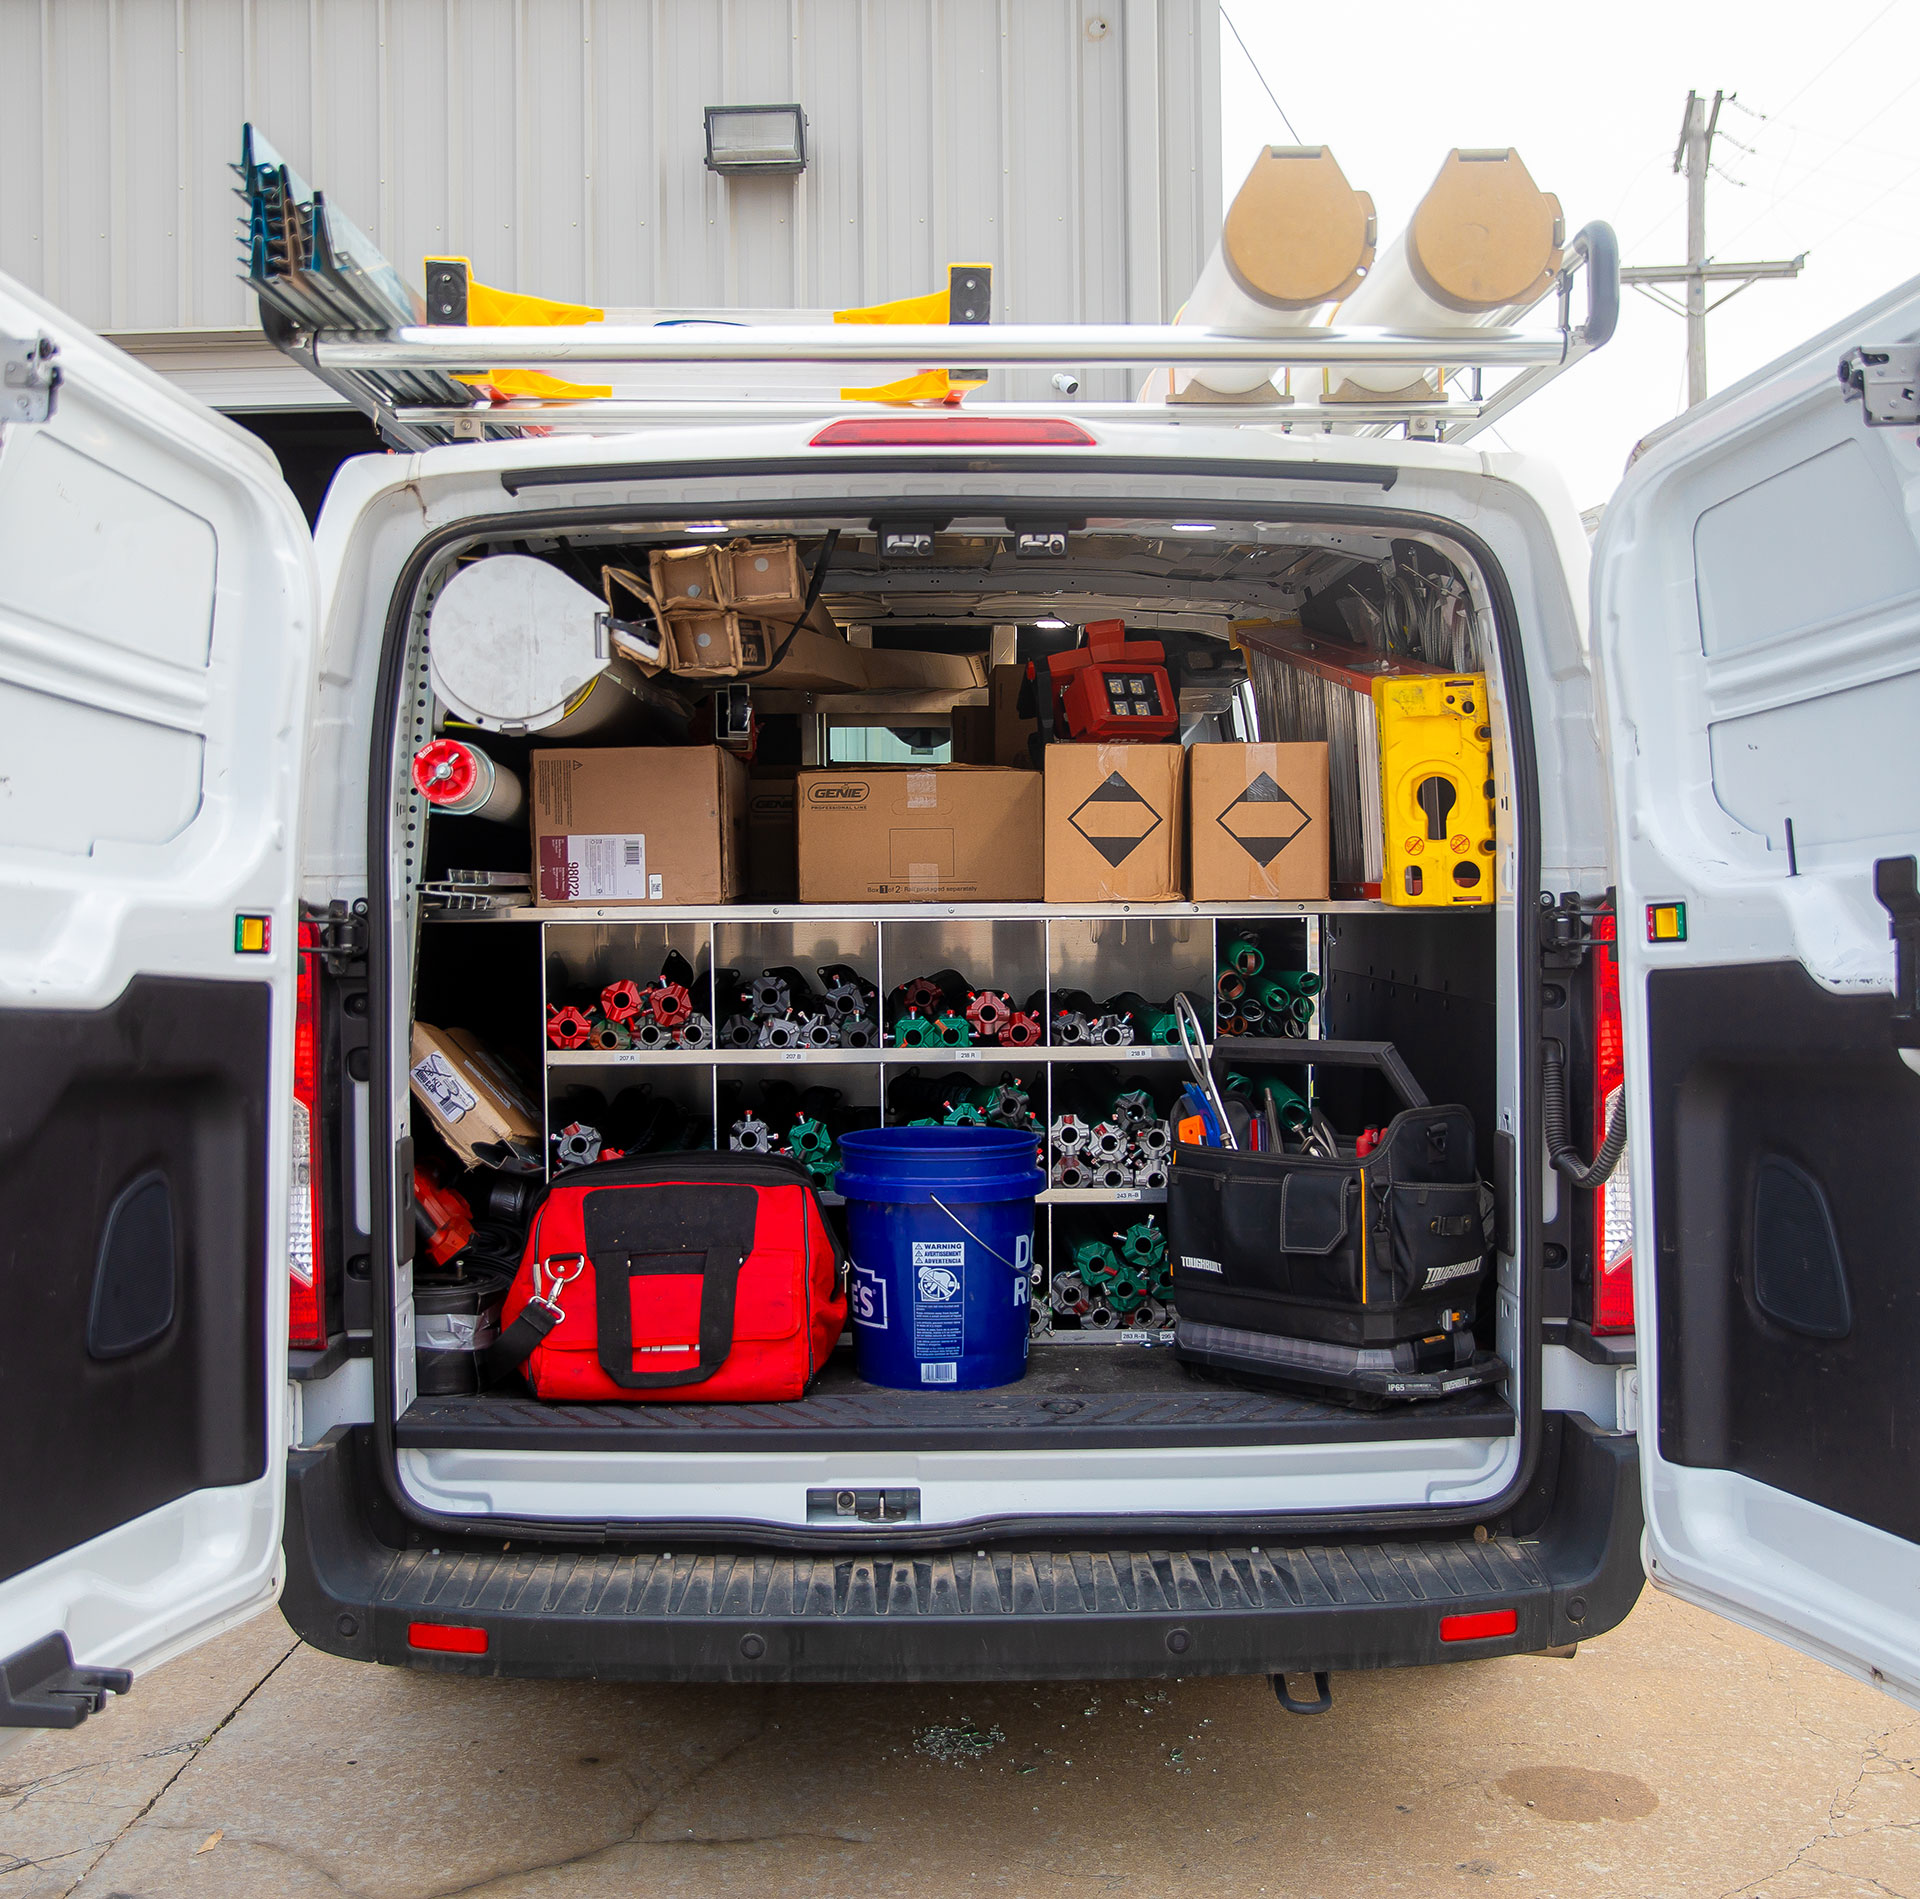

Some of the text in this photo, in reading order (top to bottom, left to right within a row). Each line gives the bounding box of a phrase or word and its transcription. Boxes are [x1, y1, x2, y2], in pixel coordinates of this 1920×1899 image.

[814, 787, 865, 799] GENIE
[567, 862, 579, 897] 98022
[1180, 1255, 1223, 1274] TOUGHBUILT
[1424, 1255, 1483, 1284] TOUGHBUILT
[1387, 1383, 1405, 1392] IP65
